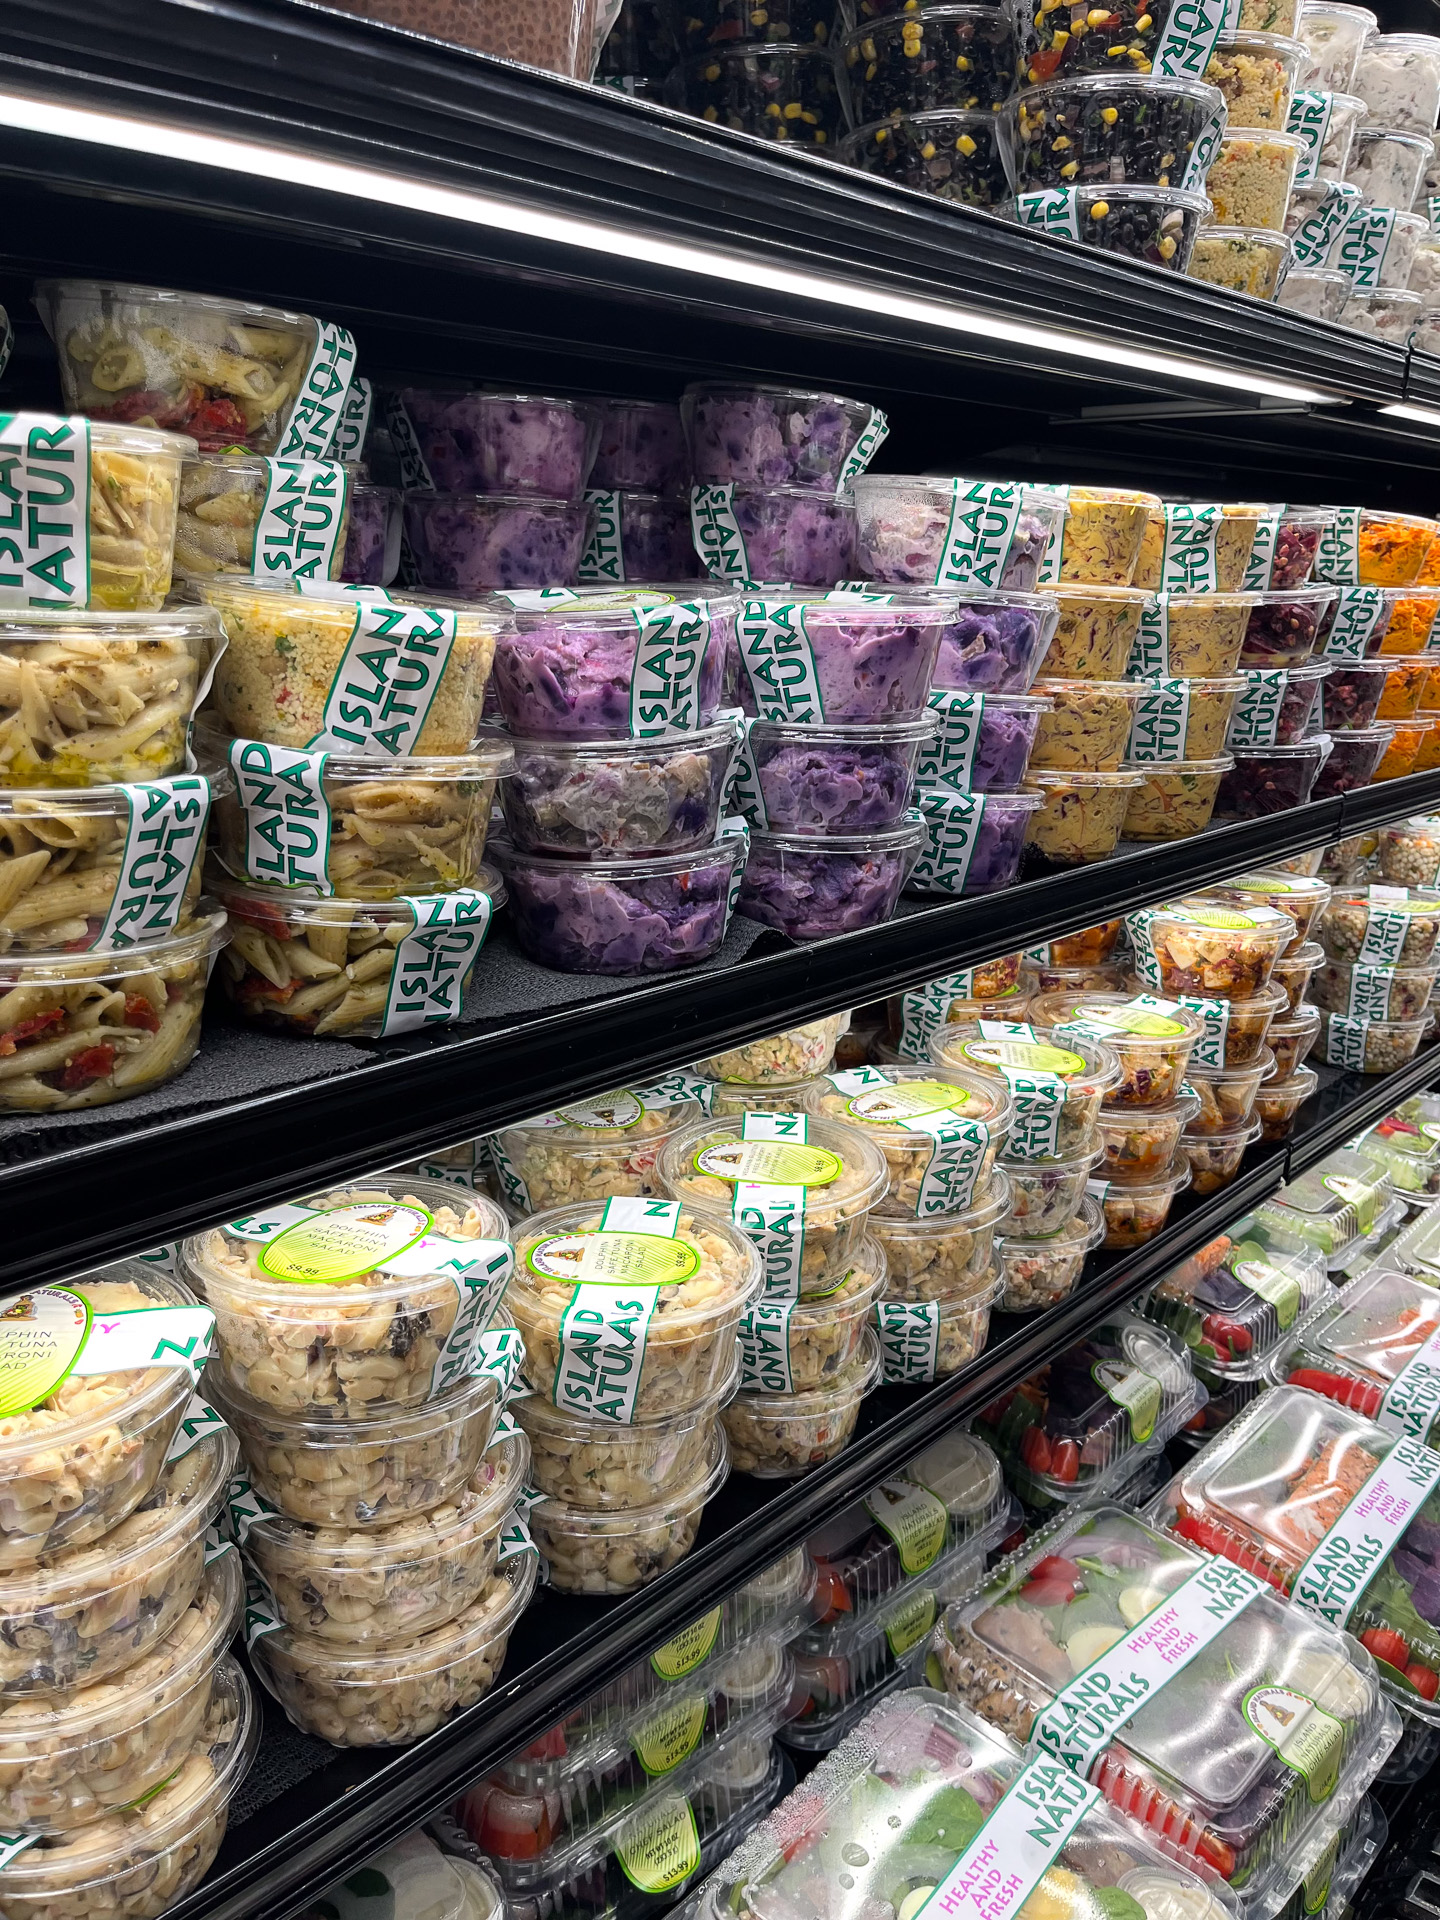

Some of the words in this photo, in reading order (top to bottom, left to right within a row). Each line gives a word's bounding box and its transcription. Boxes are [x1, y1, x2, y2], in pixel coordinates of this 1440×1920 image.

[138, 779, 201, 942] ISLAN
[305, 1233, 379, 1254] MACARONI
[313, 1227, 347, 1239] SAFE
[353, 1235, 388, 1248] TUNA
[328, 1223, 390, 1240] DOLPHIN
[310, 1242, 356, 1256] SALAD
[0, 1351, 52, 1359] RONI
[562, 1308, 605, 1413] ISLAND
[901, 1503, 928, 1520] ISLAND
[1354, 1478, 1390, 1519] HEALTHY
[1376, 1493, 1397, 1518] AND
[902, 1508, 939, 1532] NATURALS
[1385, 1498, 1412, 1526] FRESH
[904, 1530, 922, 1543] CHEF
[924, 1515, 946, 1531] SALAD
[1127, 1607, 1181, 1654] HEALTHY
[1153, 1626, 1182, 1652] AND
[676, 1648, 701, 1669] $13.99
[1160, 1632, 1200, 1664] FRESH
[1036, 1671, 1113, 1759] ISLAND
[1294, 1723, 1317, 1750] ISLAND
[1300, 1723, 1332, 1760] NATURALS
[665, 1741, 690, 1764] $13.99
[656, 1811, 686, 1836] SALAD
[662, 1860, 689, 1882] $13.99
[938, 1839, 1000, 1915] HEALTHY
[970, 1869, 1002, 1909] AND
[979, 1873, 1024, 1920] FRESH
